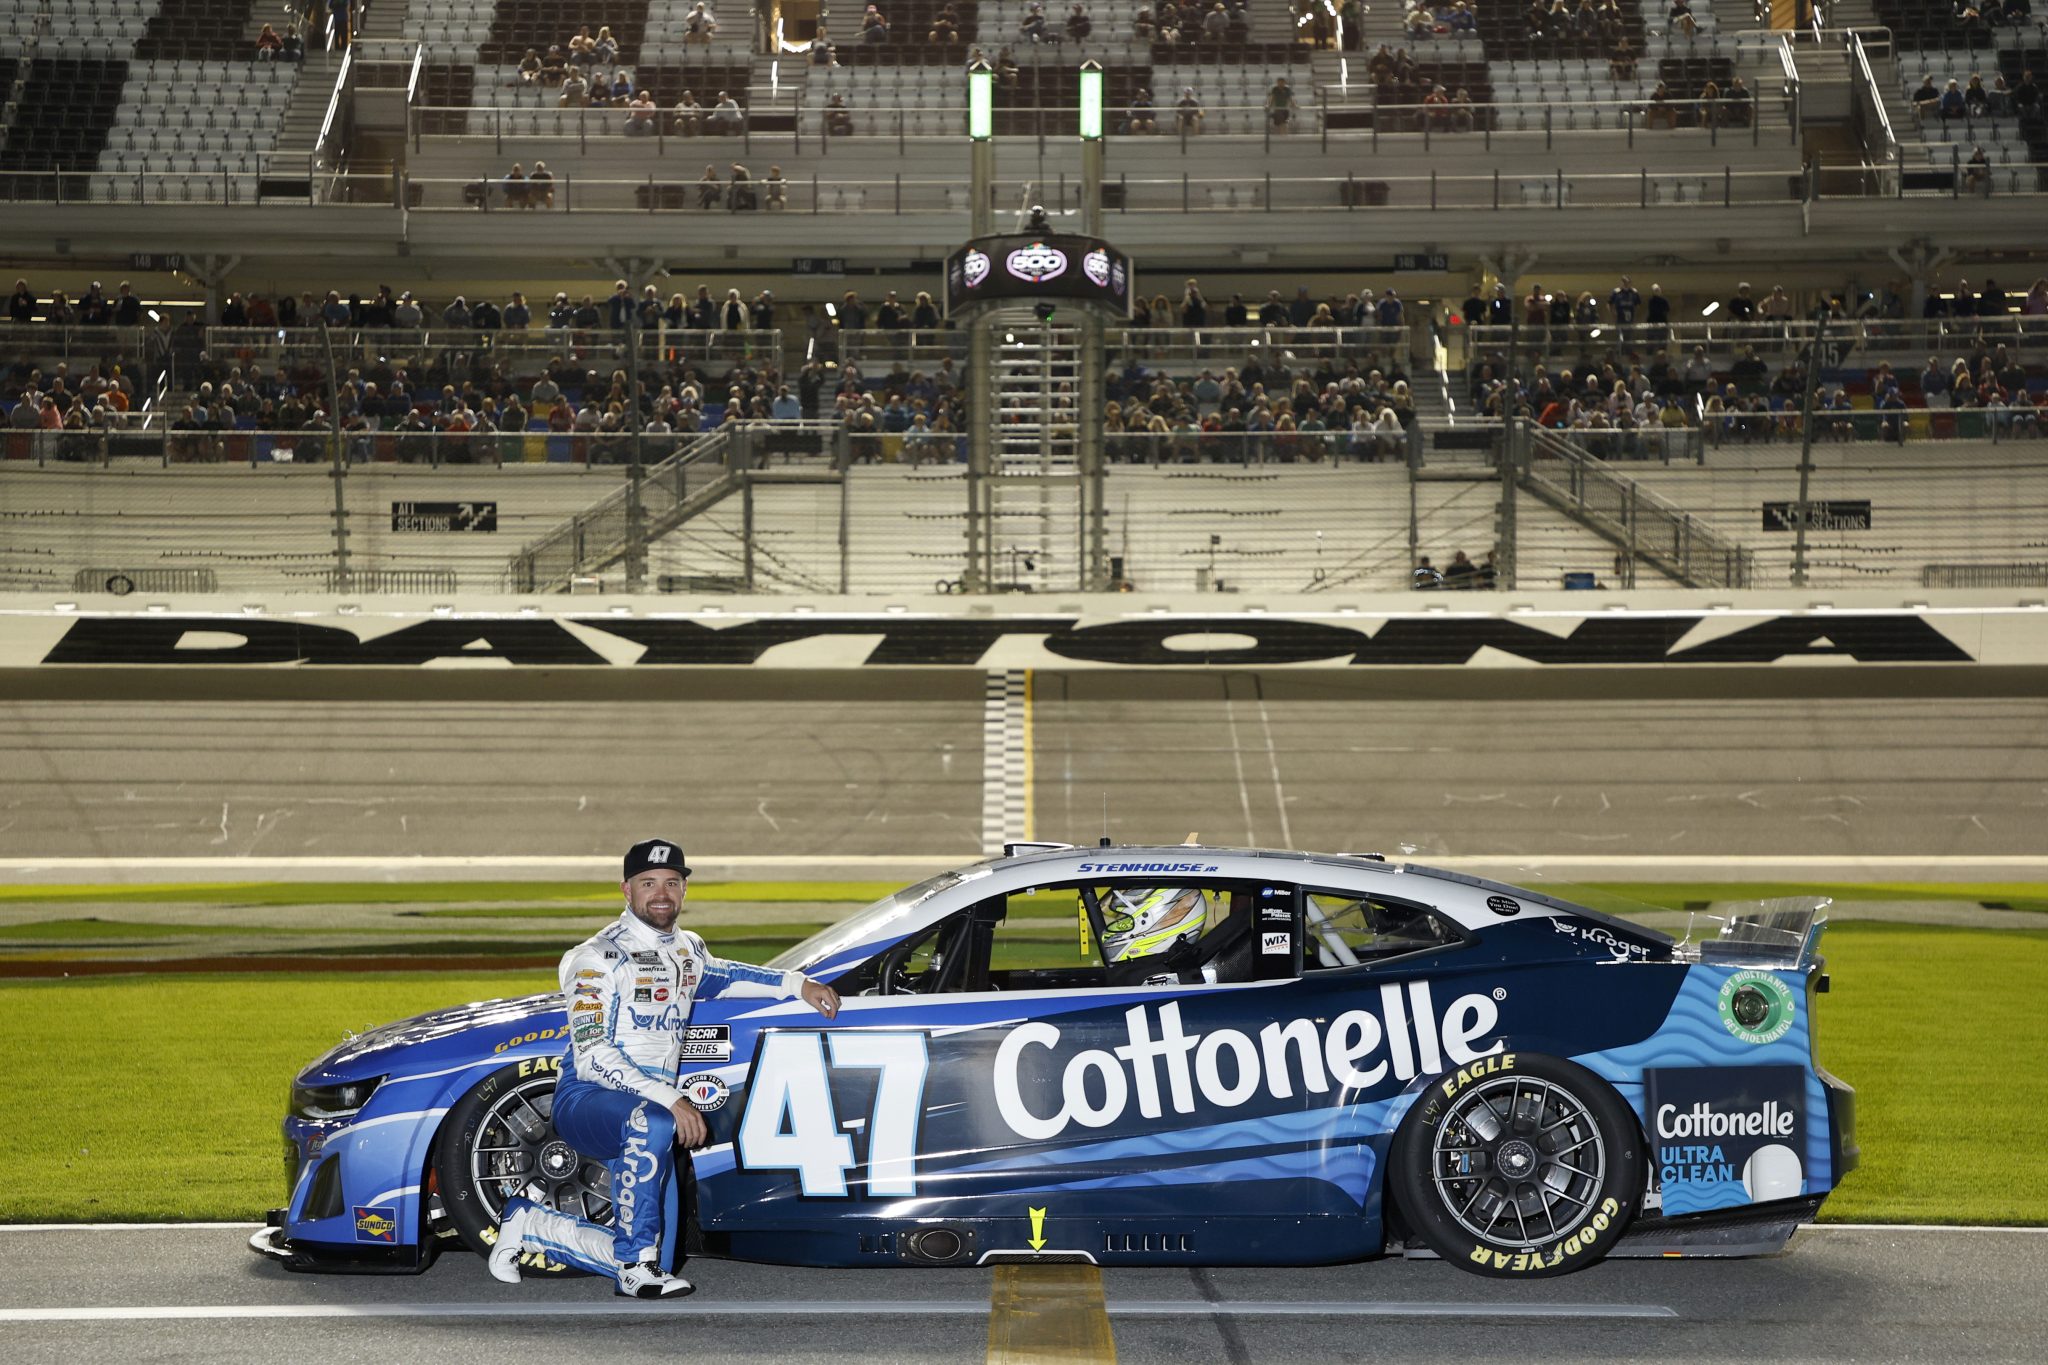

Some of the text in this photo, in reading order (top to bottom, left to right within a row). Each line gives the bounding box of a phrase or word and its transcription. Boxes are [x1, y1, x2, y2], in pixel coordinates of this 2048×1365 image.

[1012, 255, 1062, 270] 500
[1812, 502, 1829, 516] ALL
[397, 516, 450, 532] SECTIONS
[1812, 515, 1866, 530] SECTIONS
[40, 616, 1976, 666] DAYTONA
[647, 846, 671, 863] 47
[1077, 863, 1204, 873] STENHOUSE
[1264, 934, 1288, 947] WIX
[1581, 927, 1651, 959] Kroger
[1721, 979, 1734, 997] GET
[683, 1028, 719, 1040] ASCAR
[1723, 1018, 1740, 1035] GET
[494, 1028, 557, 1054] GOOD
[682, 1043, 719, 1054] SERIES
[518, 1056, 564, 1078] EAG
[1441, 1053, 1516, 1099] EAGLE
[476, 1077, 498, 1101] L47
[737, 1031, 931, 1199] 47
[1421, 1099, 1441, 1126] L47
[1656, 1100, 1794, 1139] Cottonelle
[1661, 1145, 1726, 1165] ULTRA
[1660, 1164, 1734, 1185] CLEAN
[618, 1136, 659, 1237] Kroger
[358, 1220, 393, 1231] SUNOCO
[1469, 1197, 1620, 1271] GOODYEAR
